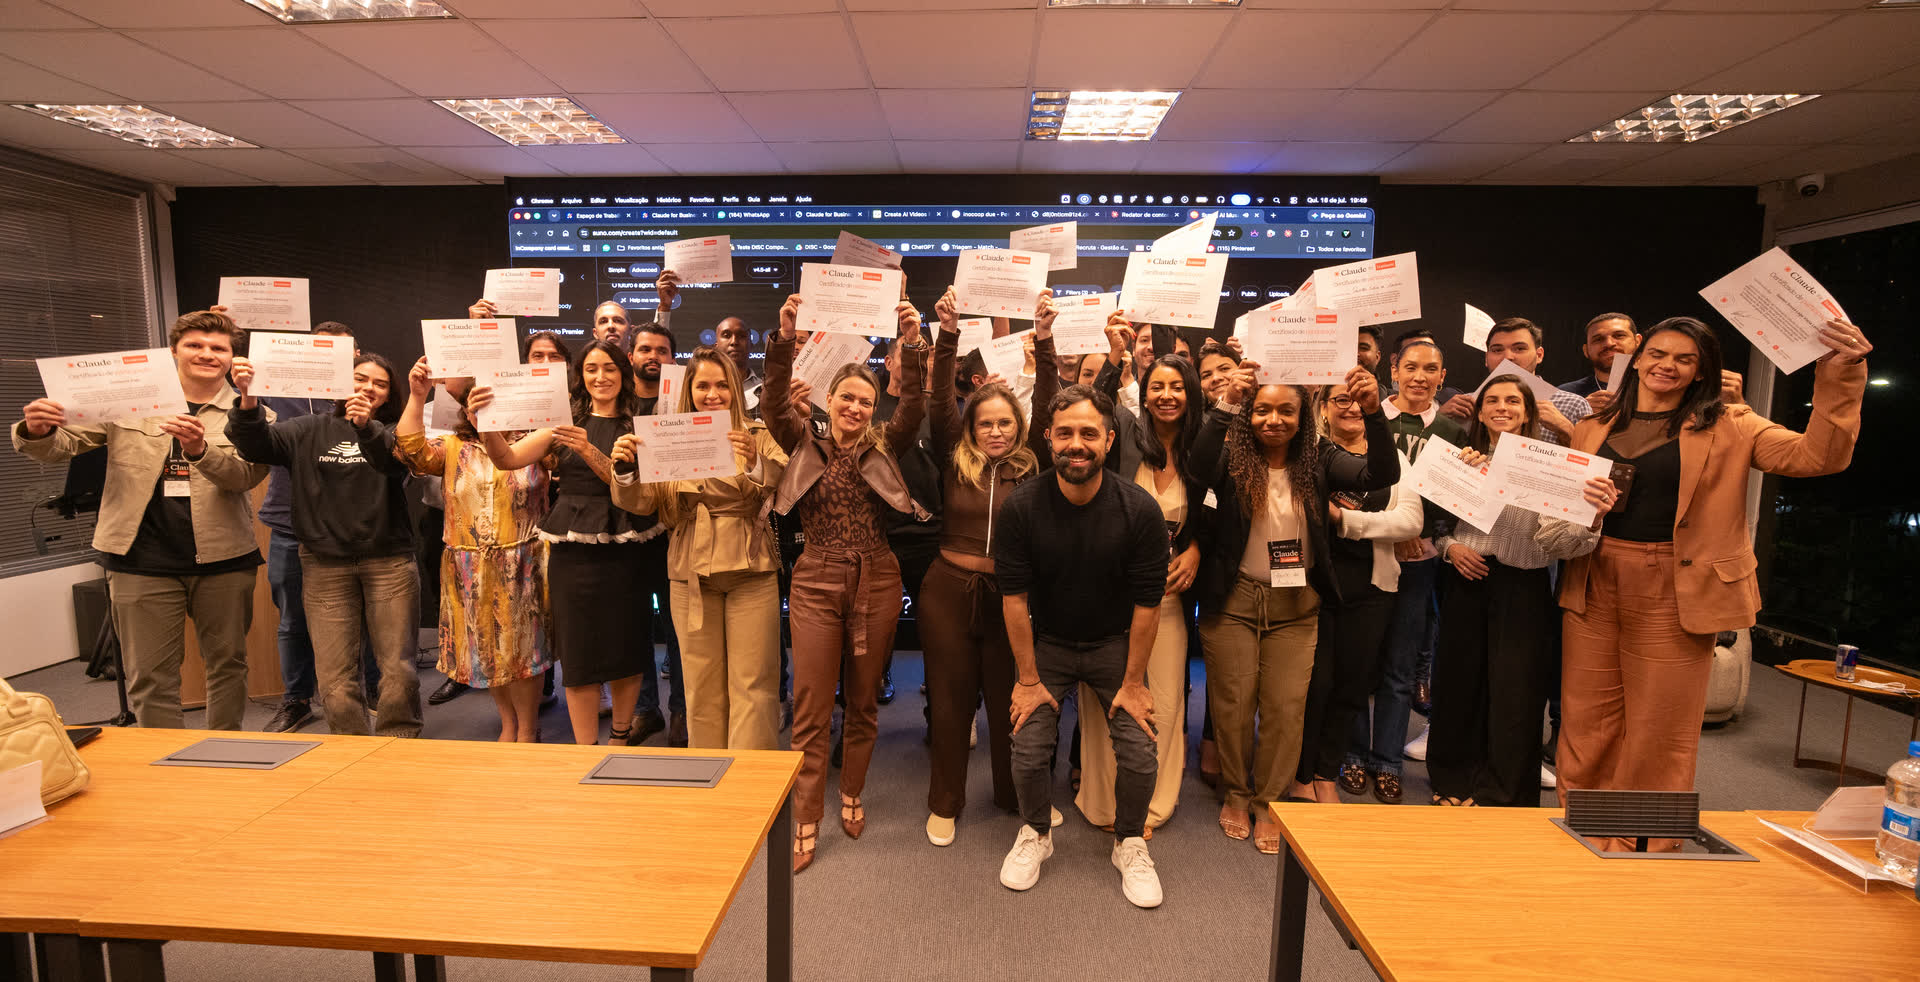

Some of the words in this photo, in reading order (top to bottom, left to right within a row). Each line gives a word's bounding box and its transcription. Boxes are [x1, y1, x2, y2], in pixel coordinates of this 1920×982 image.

[828, 270, 854, 278] Claude
[1341, 267, 1366, 276] Claude
[1790, 272, 1816, 295] Claude
[76, 359, 111, 368] Claude
[1528, 445, 1557, 457] Claude
[1337, 491, 1358, 506] Claude
